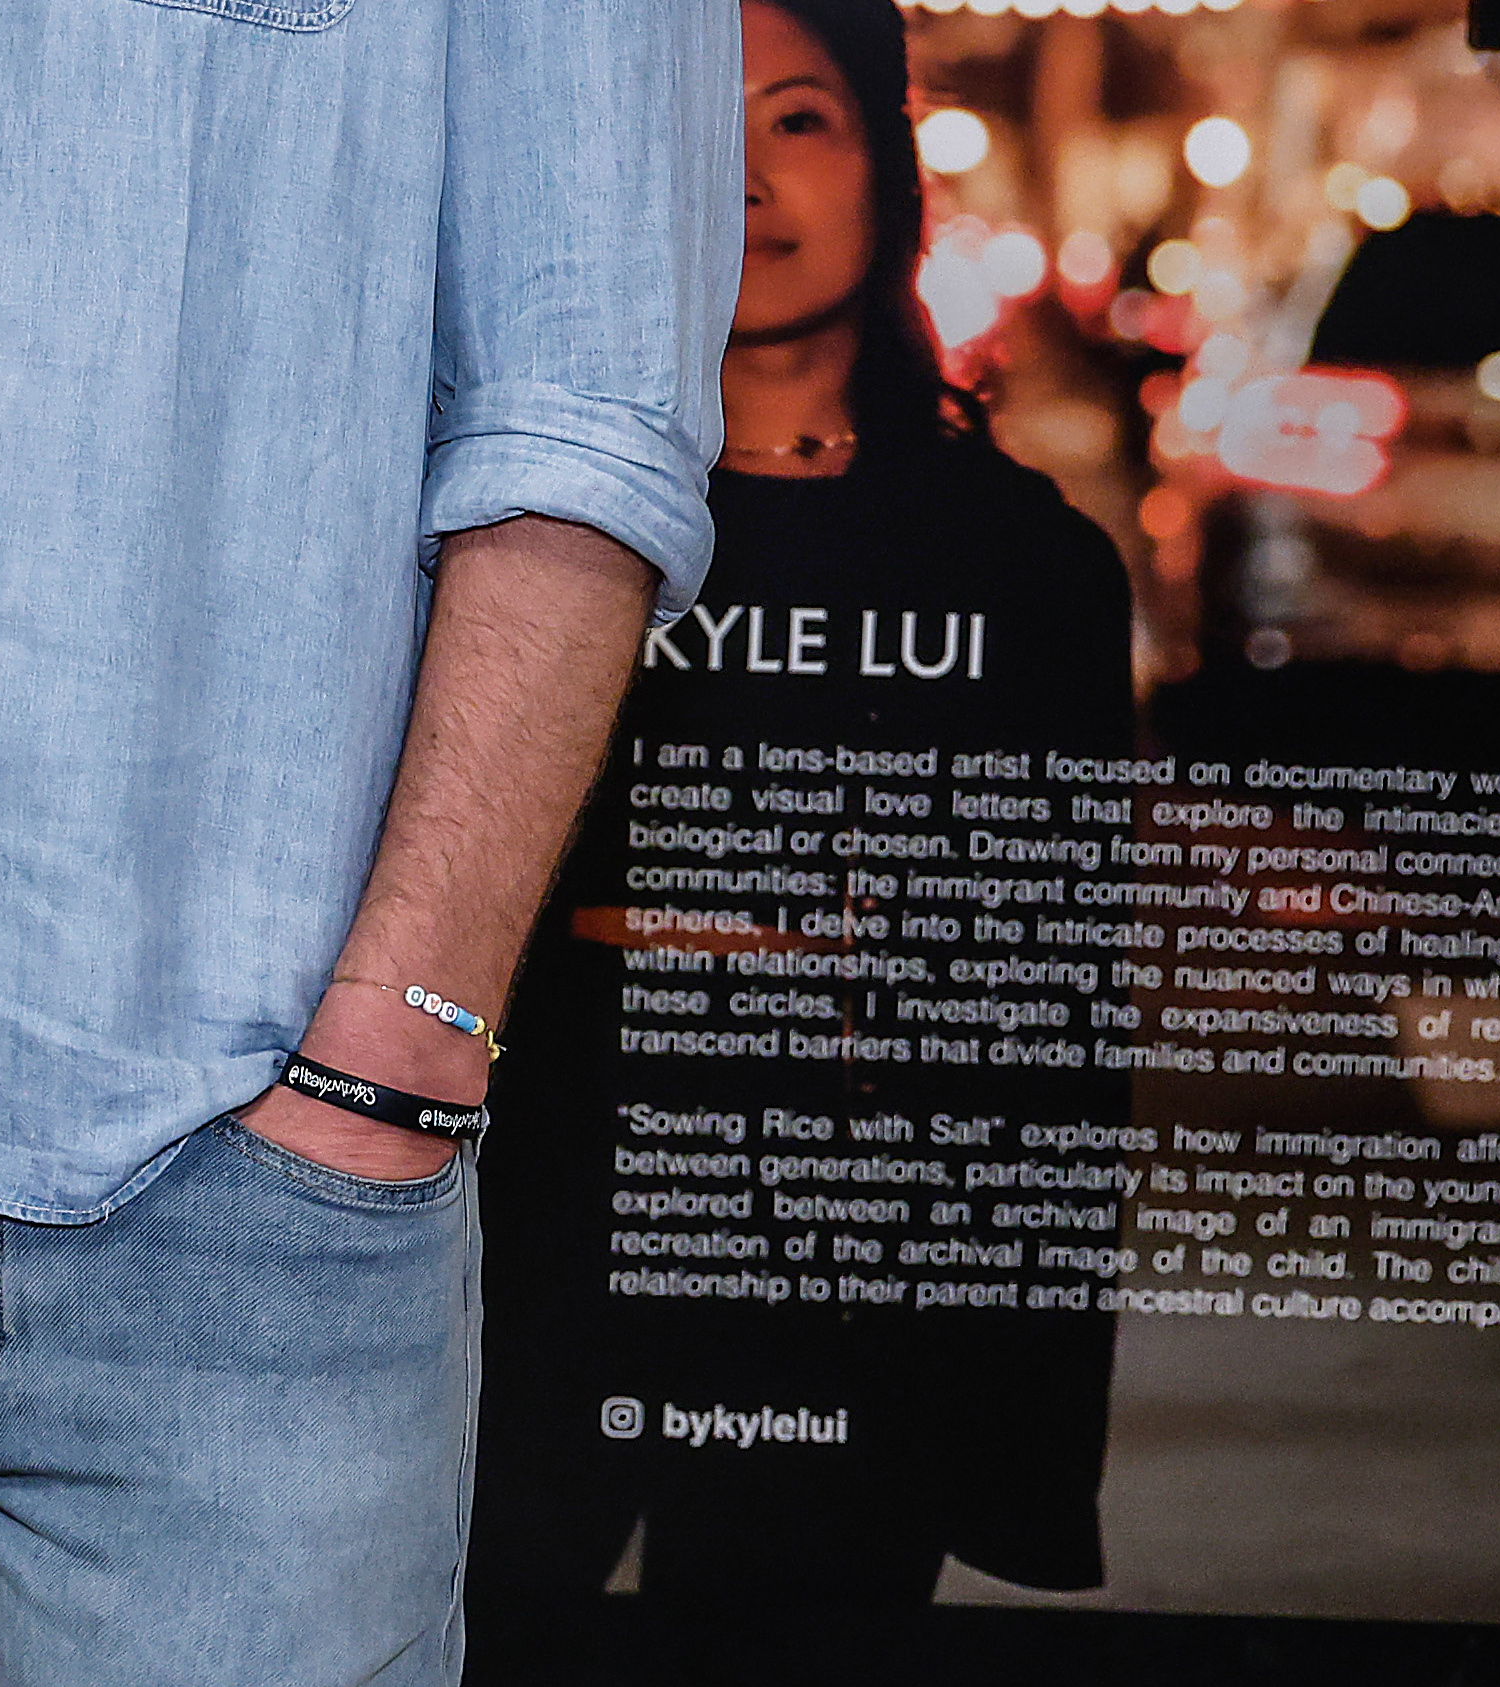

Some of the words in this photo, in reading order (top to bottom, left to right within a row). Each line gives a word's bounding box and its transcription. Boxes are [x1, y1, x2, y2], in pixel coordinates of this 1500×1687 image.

[643, 603, 828, 676] KYLE
[859, 609, 986, 680] LUI
[635, 737, 641, 766] I
[657, 743, 709, 768] am
[722, 745, 744, 770] a
[758, 741, 938, 776] lens-based
[951, 749, 1031, 779] artist
[1046, 751, 1176, 784] focused
[1189, 761, 1230, 786] on
[1244, 757, 1457, 800] documentary
[630, 780, 732, 810] create
[752, 782, 844, 814] visual
[865, 785, 932, 816] love
[952, 788, 1051, 820] letters
[1072, 792, 1132, 823] that
[1152, 797, 1273, 832] explore
[1293, 800, 1344, 830] the
[630, 819, 782, 857] biological
[790, 829, 824, 854] or
[832, 826, 957, 859] chosen.
[969, 830, 1101, 870] Drawing
[1111, 835, 1182, 866] from
[1190, 843, 1240, 874] my
[1248, 844, 1387, 875] personal
[627, 863, 835, 895] communities:
[847, 867, 898, 897] the
[907, 869, 1064, 907] immigrant
[1074, 878, 1250, 915] community
[1258, 882, 1322, 912] and
[626, 902, 763, 938] spheres,
[779, 906, 785, 935] I
[801, 907, 889, 939] delve
[902, 910, 961, 941] into
[974, 913, 1024, 943] the
[1037, 915, 1164, 948] intricate
[1177, 924, 1343, 955] processes
[1356, 926, 1387, 955] of
[624, 941, 714, 972] within
[727, 945, 935, 985] relationships,
[950, 953, 1098, 992] exploring
[1112, 957, 1162, 988] the
[1175, 964, 1316, 993] nuanced
[1328, 970, 1410, 1002] ways
[1423, 968, 1451, 998] in
[622, 982, 710, 1014] these
[729, 986, 843, 1018] circles.
[868, 990, 874, 1020] I
[897, 991, 1070, 1030] investigate
[1091, 998, 1141, 1028] the
[1161, 1004, 1398, 1037] expansiveness
[1417, 1009, 1452, 1039] of
[621, 1021, 780, 1056] transcend
[789, 1027, 911, 1061] barriers
[920, 1032, 980, 1063] that
[988, 1034, 1086, 1067] divide
[1094, 1038, 1215, 1072] families
[1222, 1044, 1286, 1074] and
[618, 1103, 746, 1142] "Sowing
[763, 1108, 834, 1139] Rice
[849, 1111, 914, 1142] with
[930, 1114, 1005, 1145] Salt"
[1021, 1119, 1158, 1154] explores
[1173, 1122, 1241, 1153] how
[1256, 1125, 1441, 1163] immigration
[615, 1144, 751, 1178] between
[759, 1152, 955, 1188] generations,
[965, 1158, 1143, 1197] particularly
[1150, 1162, 1188, 1193] its
[1195, 1164, 1305, 1201] impact
[1313, 1173, 1355, 1198] on
[1364, 1170, 1415, 1200] the
[612, 1185, 753, 1220] explored
[774, 1189, 909, 1223] between
[930, 1200, 971, 1225] an
[992, 1199, 1116, 1230] archival
[1137, 1202, 1236, 1240] image
[1256, 1207, 1288, 1236] of
[1309, 1213, 1350, 1238] an
[611, 1227, 769, 1258] recreation
[784, 1230, 817, 1260] of
[833, 1231, 883, 1262] the
[898, 1235, 1023, 1267] archival
[1038, 1239, 1138, 1276] image
[1152, 1243, 1186, 1273] of
[1201, 1244, 1253, 1275] the
[1267, 1247, 1354, 1279] child.
[1372, 1250, 1433, 1281] The
[609, 1265, 791, 1305] relationship
[800, 1270, 831, 1300] to
[839, 1272, 908, 1303] their
[916, 1277, 1018, 1310] parent
[1026, 1280, 1089, 1310] and
[1097, 1284, 1245, 1315] ancestral
[1251, 1287, 1362, 1319] culture
[662, 1402, 849, 1449] bykylelui
